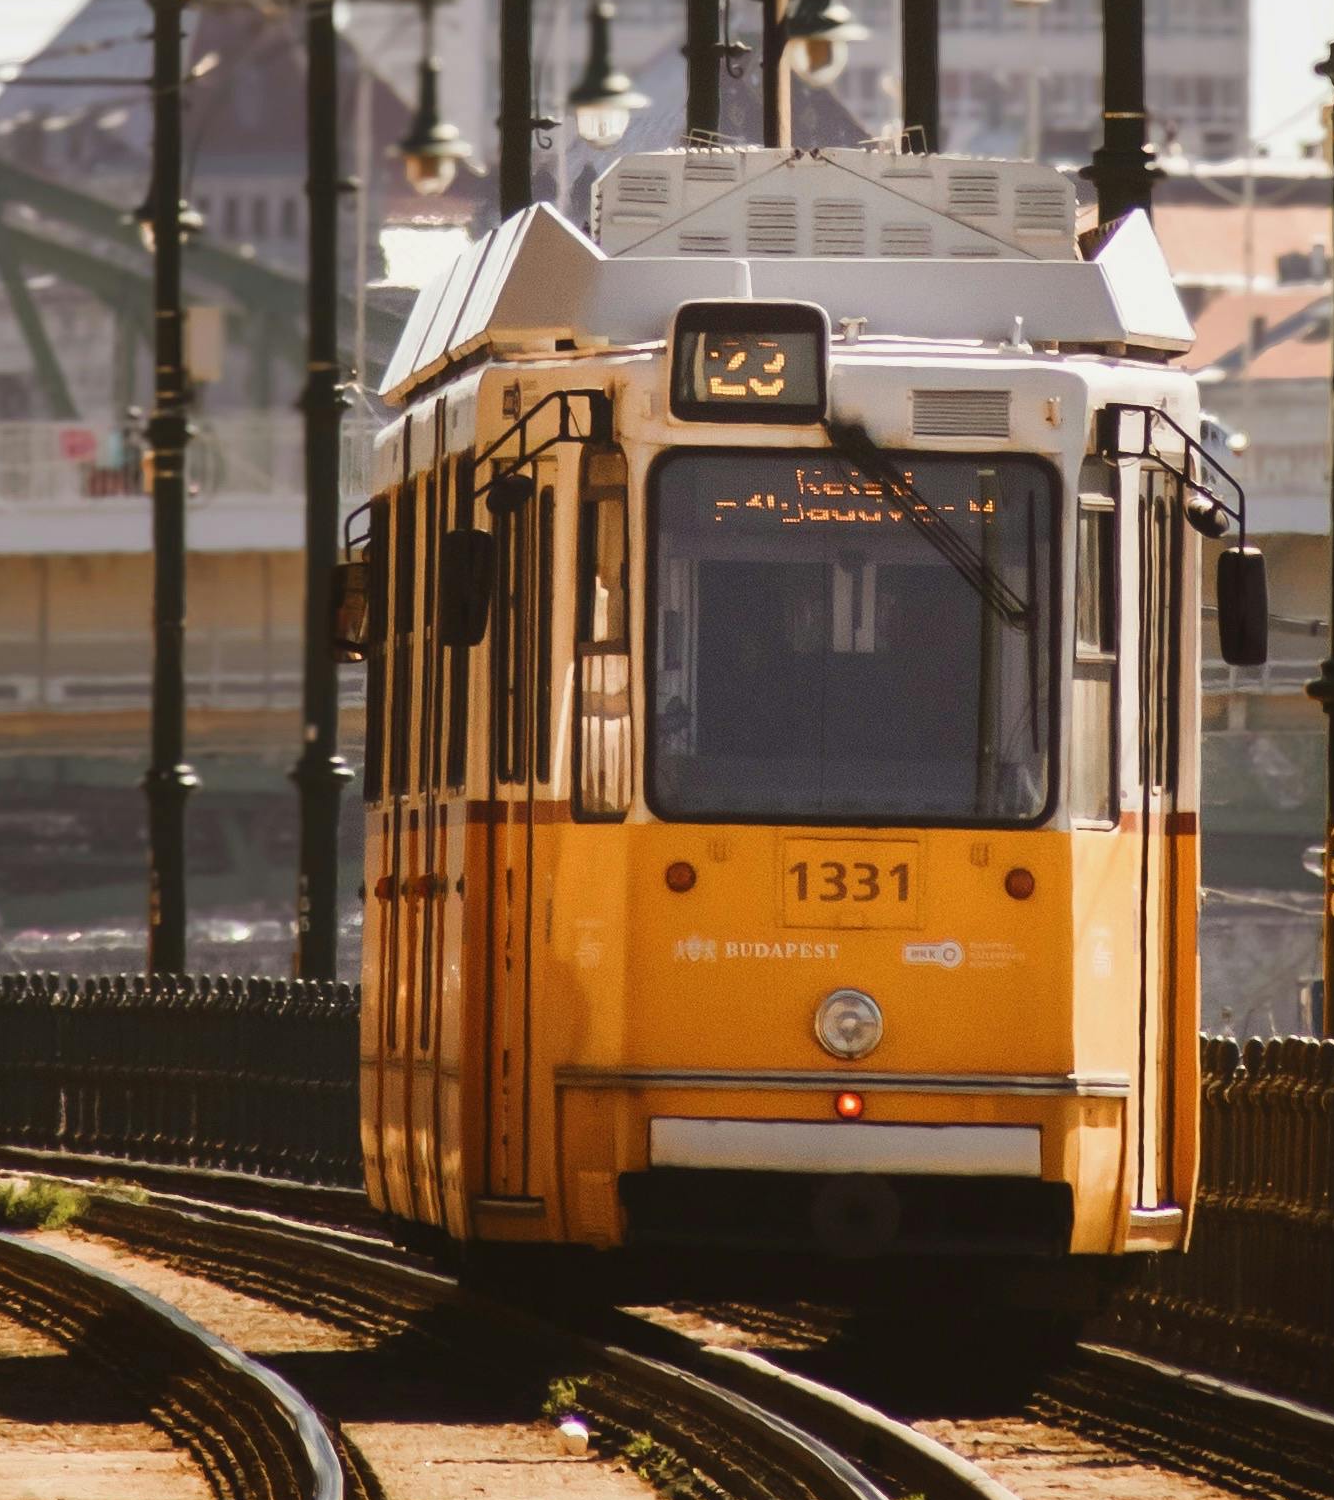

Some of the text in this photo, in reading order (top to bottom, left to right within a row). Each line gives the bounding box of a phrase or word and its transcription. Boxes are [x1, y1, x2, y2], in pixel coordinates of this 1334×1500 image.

[710, 342, 785, 397] 23
[788, 861, 910, 902] 1331
[724, 941, 840, 960] BUDAPEST
